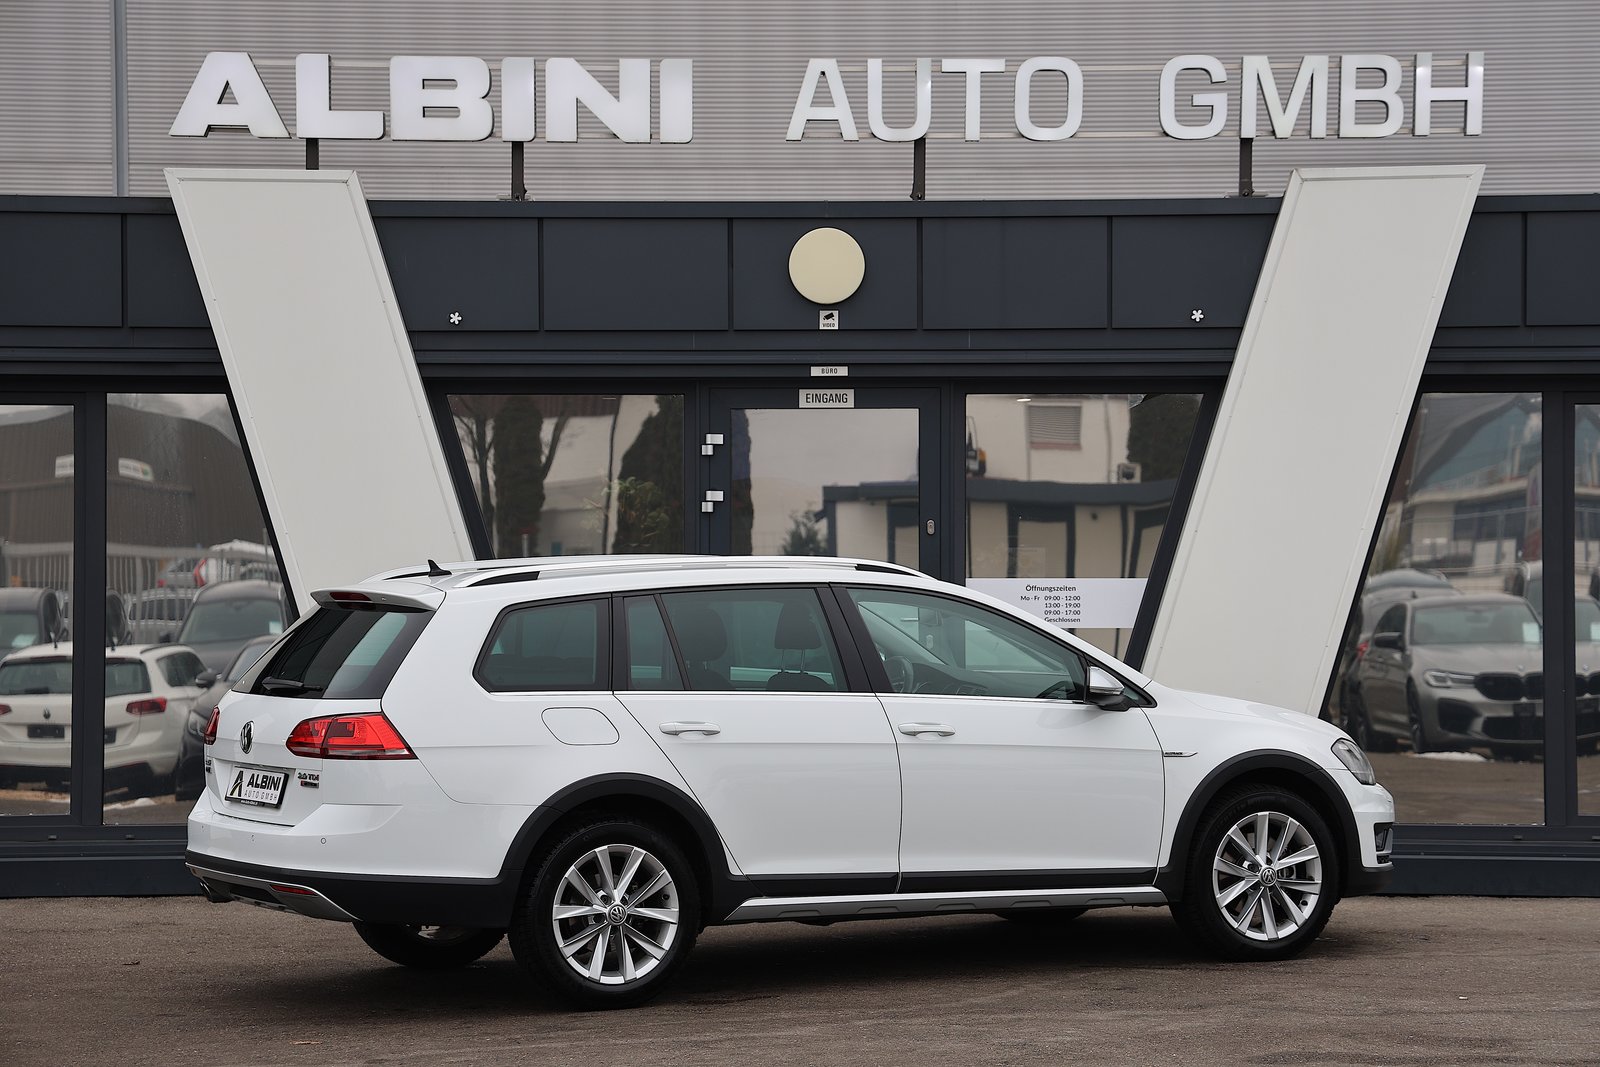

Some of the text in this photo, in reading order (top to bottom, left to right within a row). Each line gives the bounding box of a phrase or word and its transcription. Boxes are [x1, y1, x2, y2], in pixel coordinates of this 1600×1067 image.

[168, 51, 1485, 144] ALBINI AUTO GMBH
[806, 393, 848, 404] EINGANG
[247, 773, 282, 791] ALBINI
[244, 790, 278, 801] AUTO GMBH
